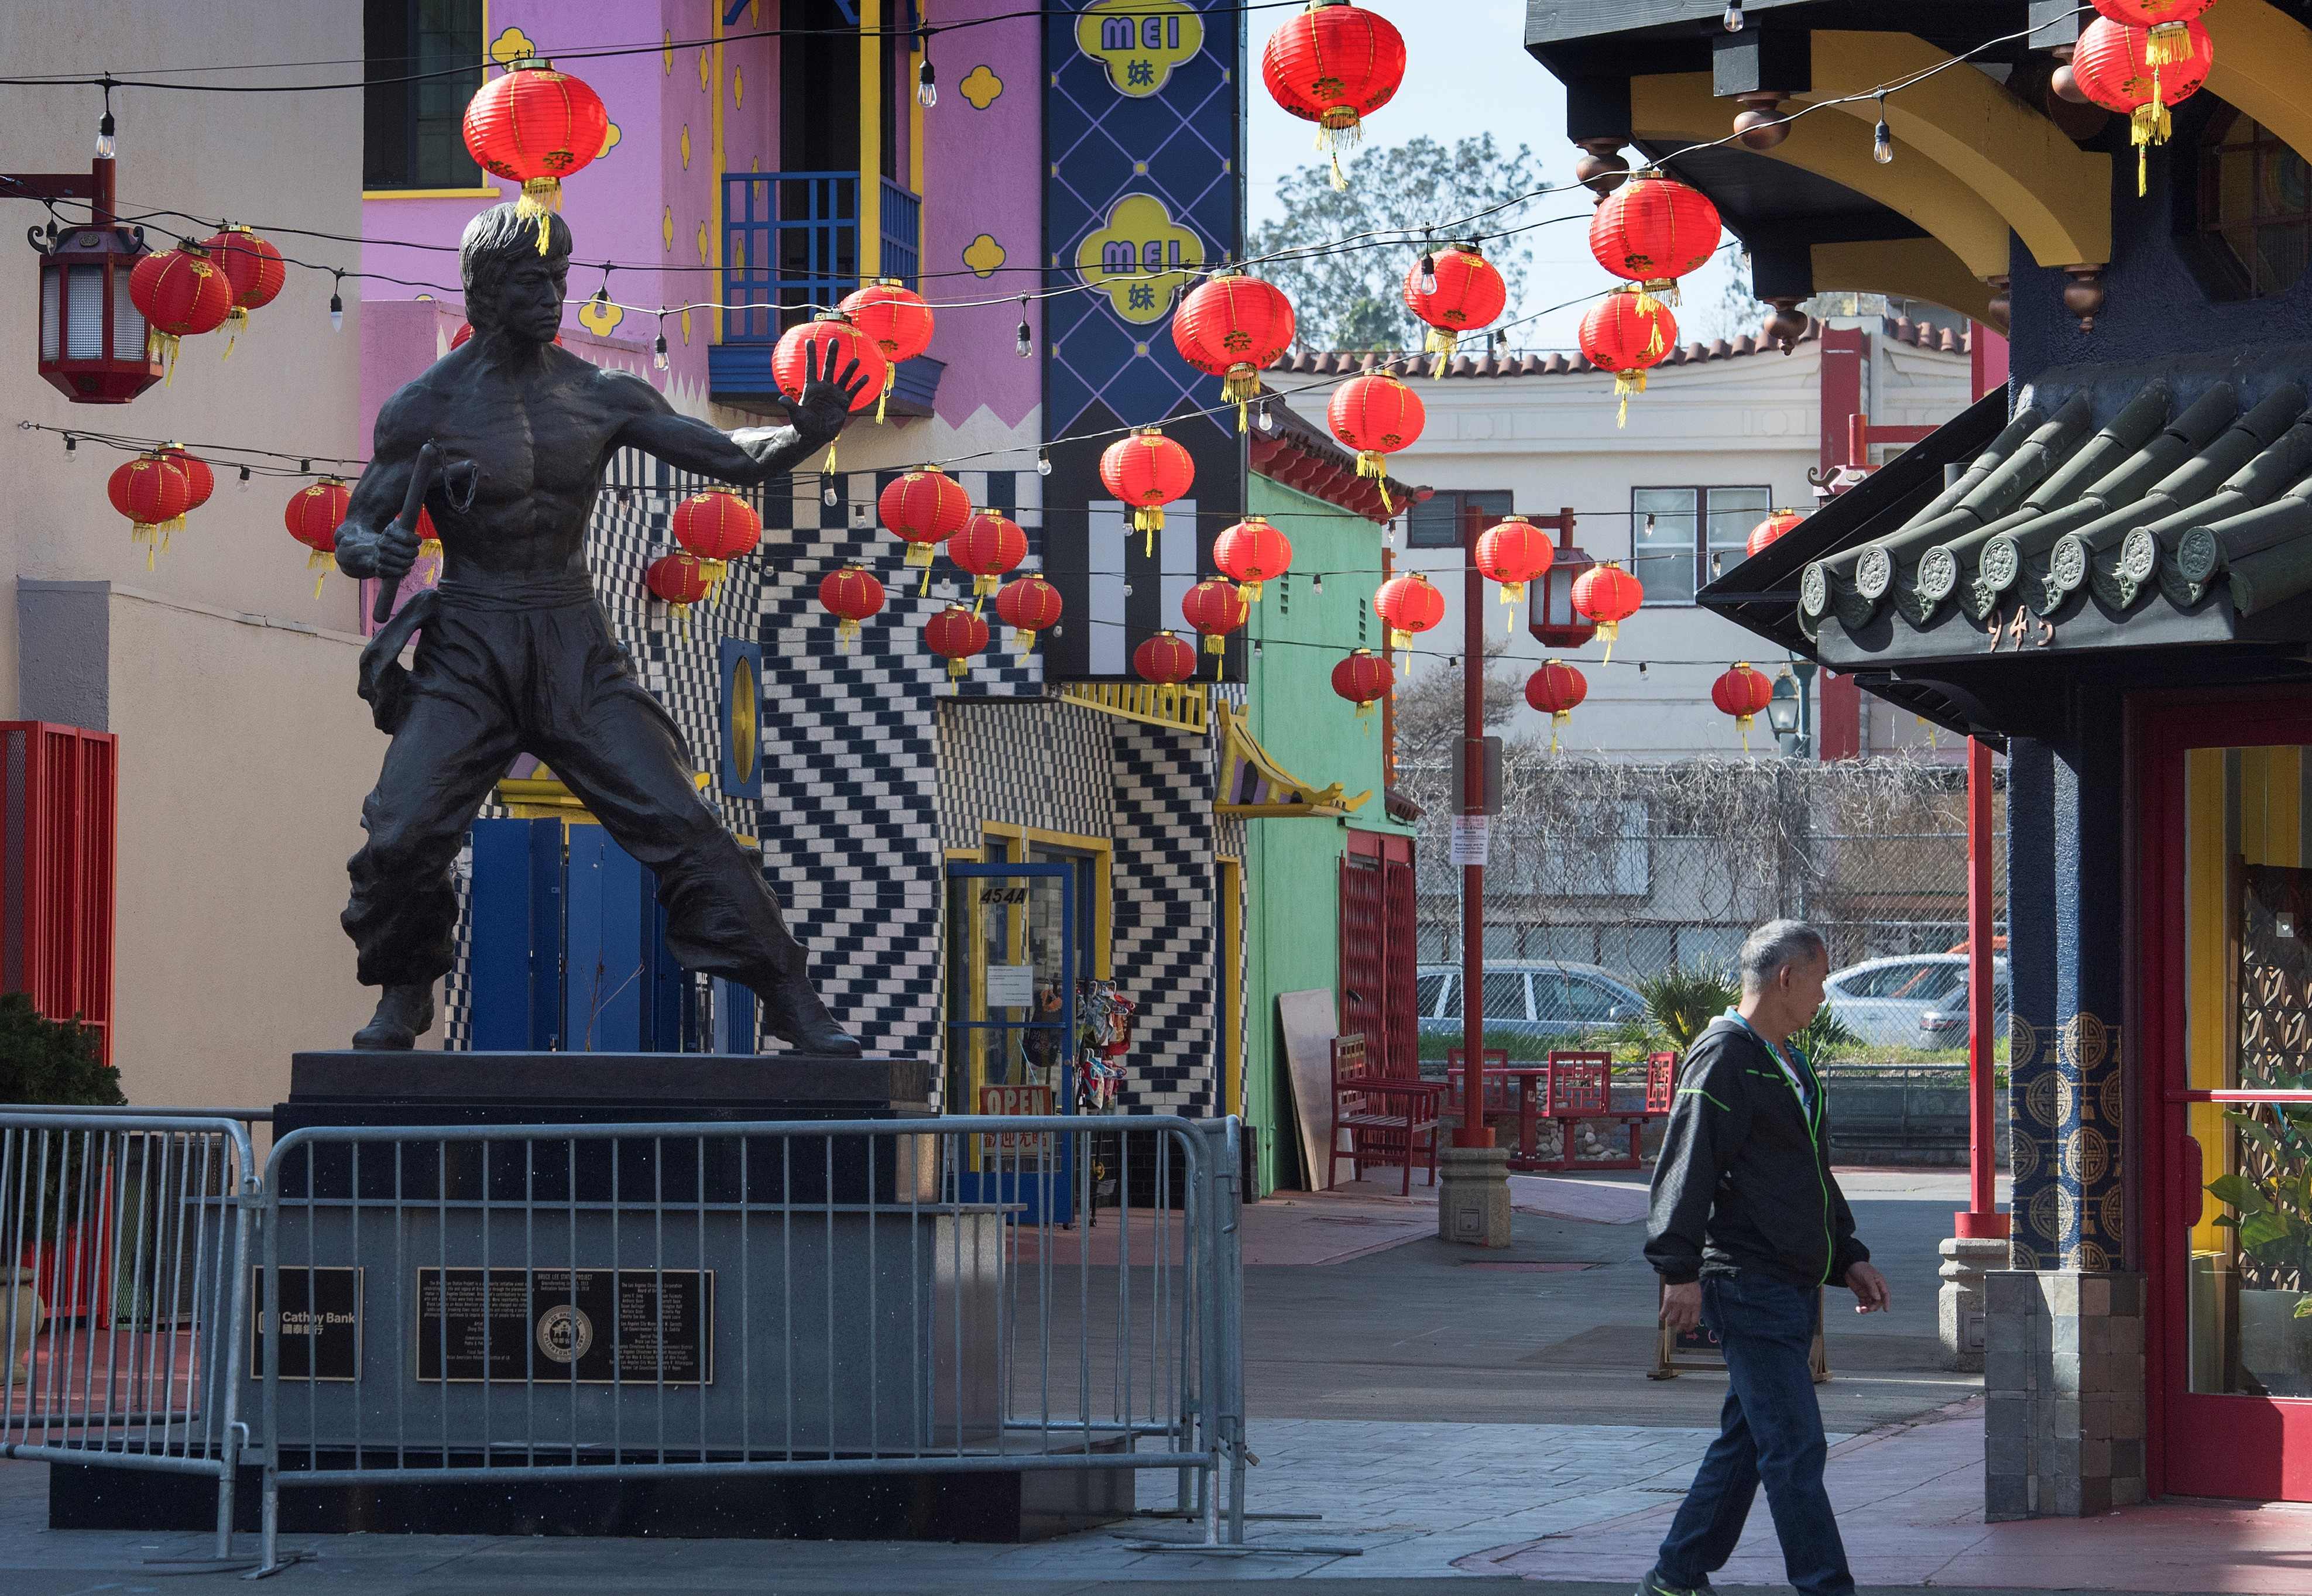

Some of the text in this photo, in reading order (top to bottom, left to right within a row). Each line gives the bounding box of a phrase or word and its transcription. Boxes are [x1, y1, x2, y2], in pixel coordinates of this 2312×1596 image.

[1102, 16, 1179, 50] MEI
[1127, 60, 1154, 87] 妹
[1102, 240, 1180, 274] MEI
[1128, 284, 1155, 310] 妹
[980, 888, 1024, 903] 454A
[987, 1089, 1045, 1116] OPEN
[283, 1311, 355, 1324] Cathy Bank
